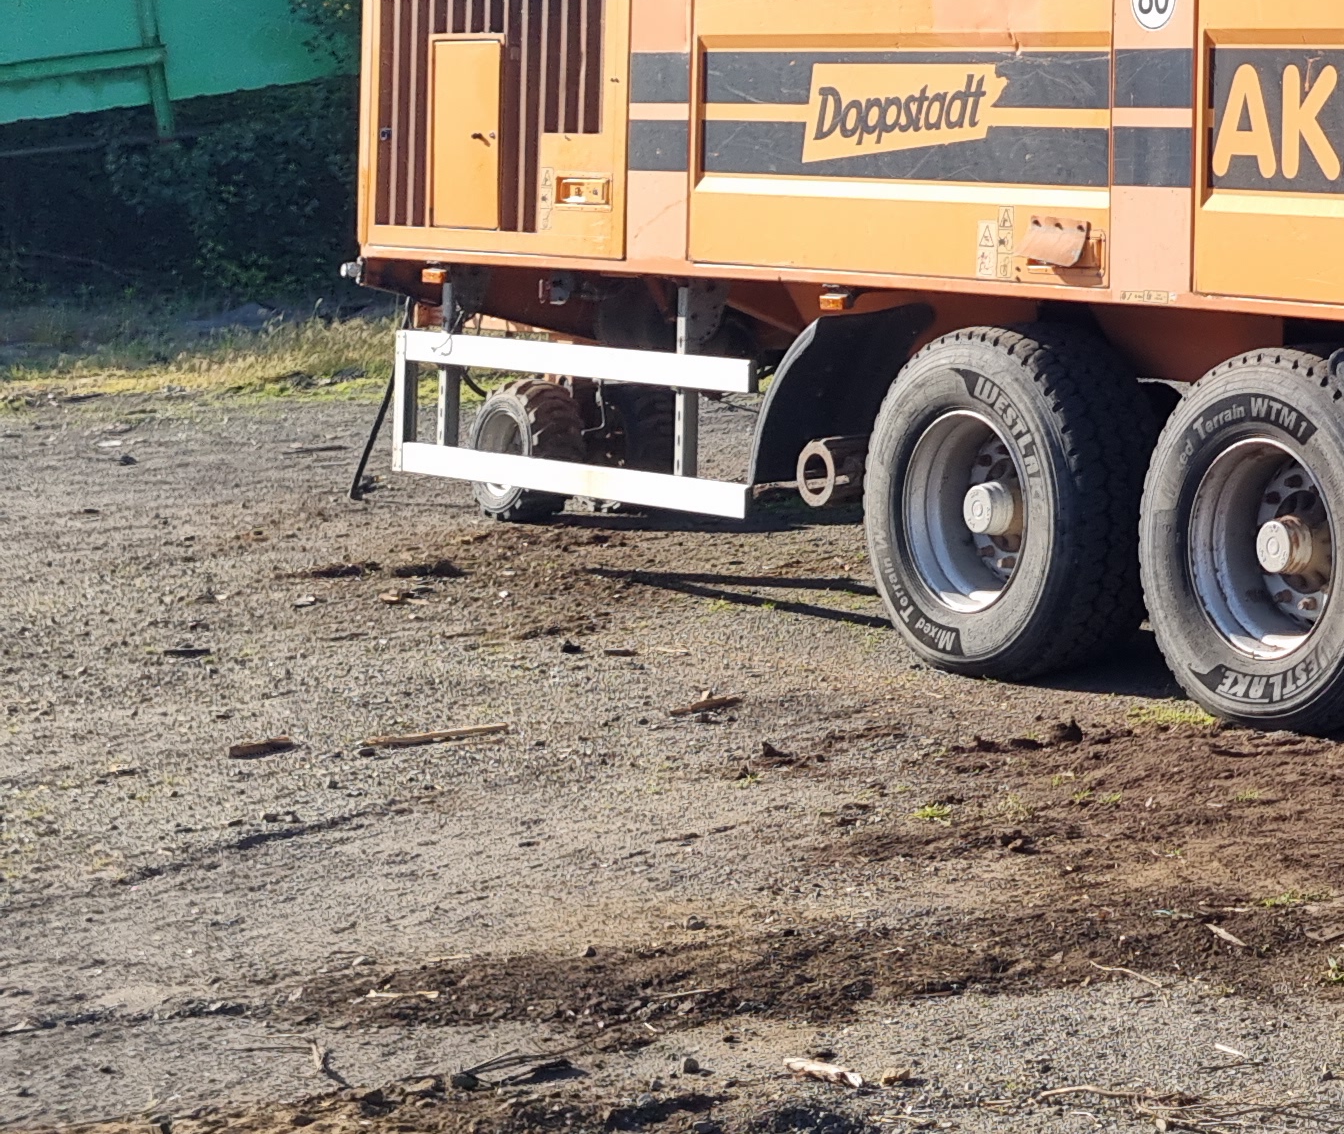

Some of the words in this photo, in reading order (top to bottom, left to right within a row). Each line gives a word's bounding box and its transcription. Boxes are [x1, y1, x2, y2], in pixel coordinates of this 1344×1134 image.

[814, 74, 986, 146] Doppstadt
[1192, 402, 1247, 440] Terrain
[883, 556, 914, 623] Terrain
[913, 619, 956, 652] Mixed
